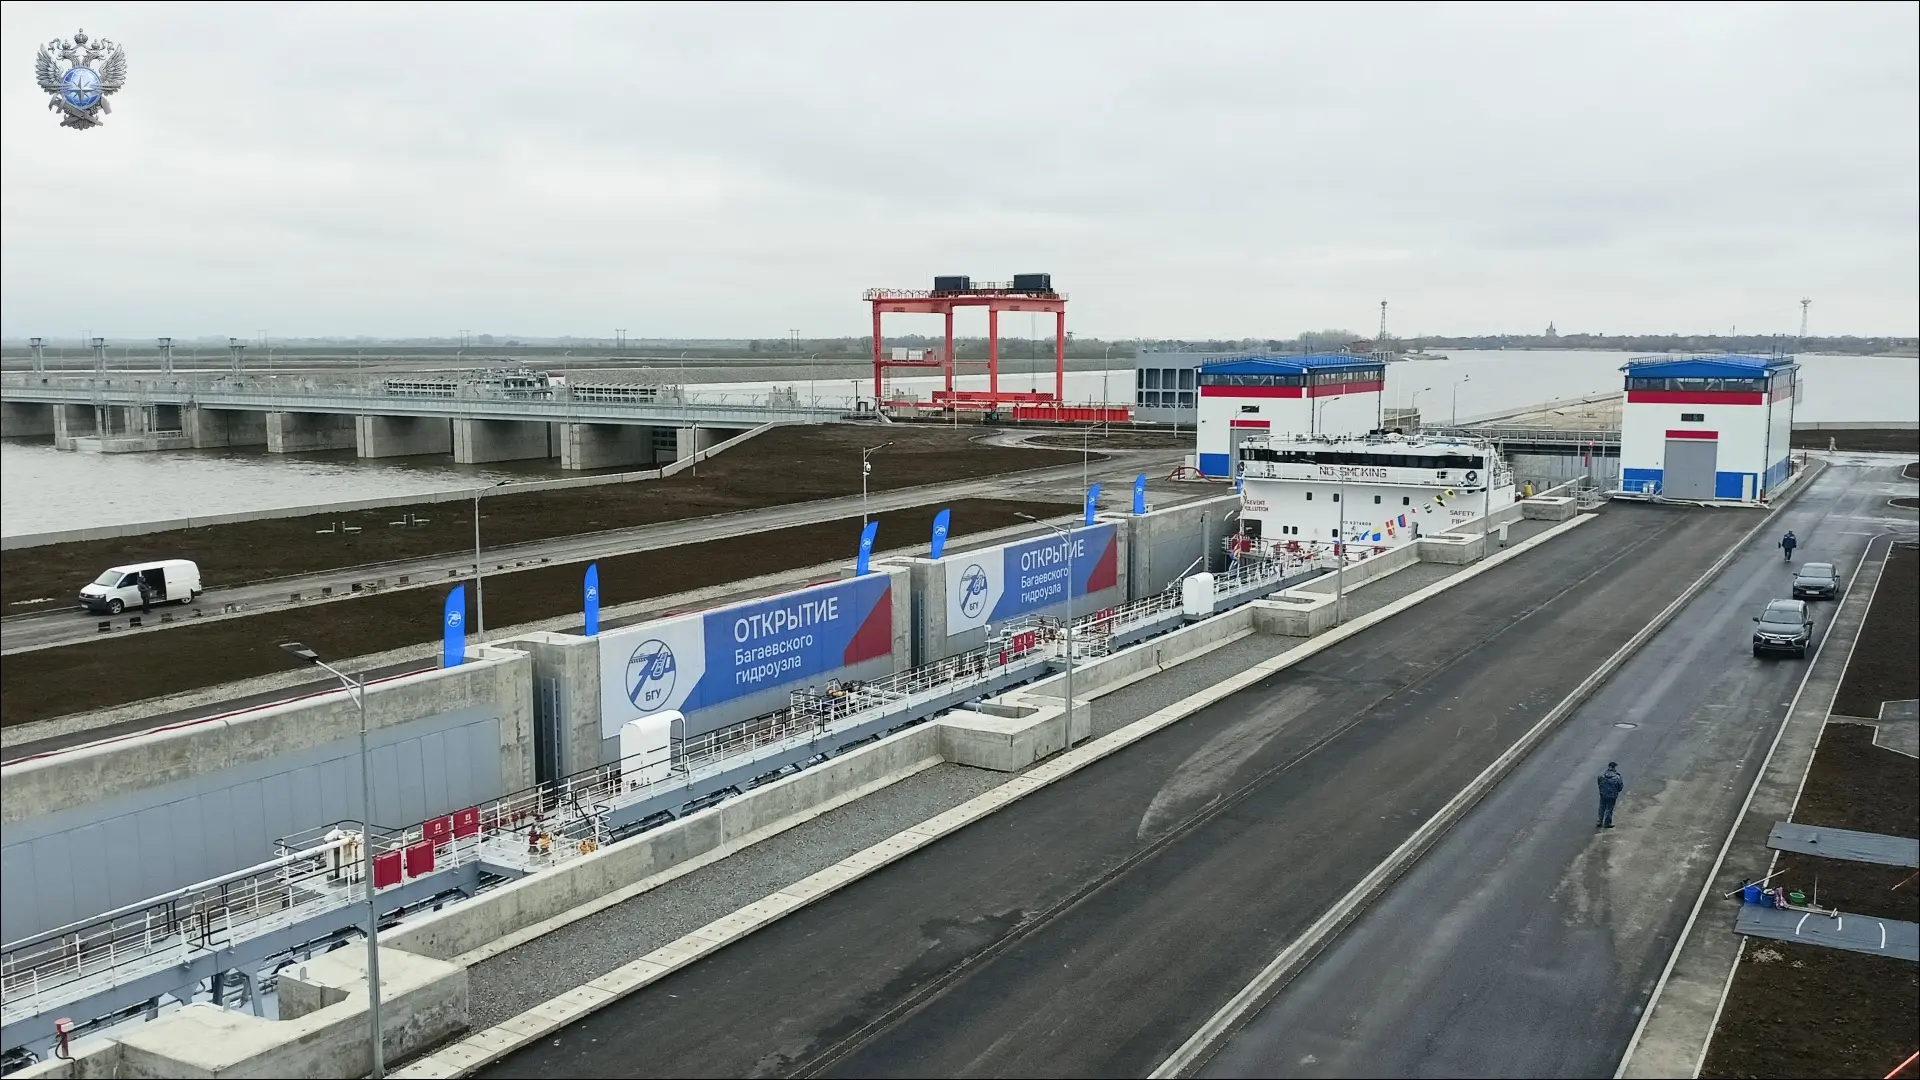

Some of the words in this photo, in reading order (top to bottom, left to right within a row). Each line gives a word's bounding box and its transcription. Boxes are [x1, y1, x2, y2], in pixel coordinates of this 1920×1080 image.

[1319, 466, 1334, 476] NO
[1339, 466, 1387, 478] SMOKING
[1449, 509, 1476, 517] SAFETY
[1021, 538, 1085, 571] ОТКРЫТИЕ
[1021, 567, 1069, 589] Багаевского
[1021, 583, 1062, 603] гидроузла
[969, 602, 979, 611] БГУ
[734, 596, 839, 643] ОТКРЫТИЕ
[735, 634, 813, 666] Багаевского
[735, 655, 802, 685] гидроузла
[645, 688, 662, 702] БГУ
